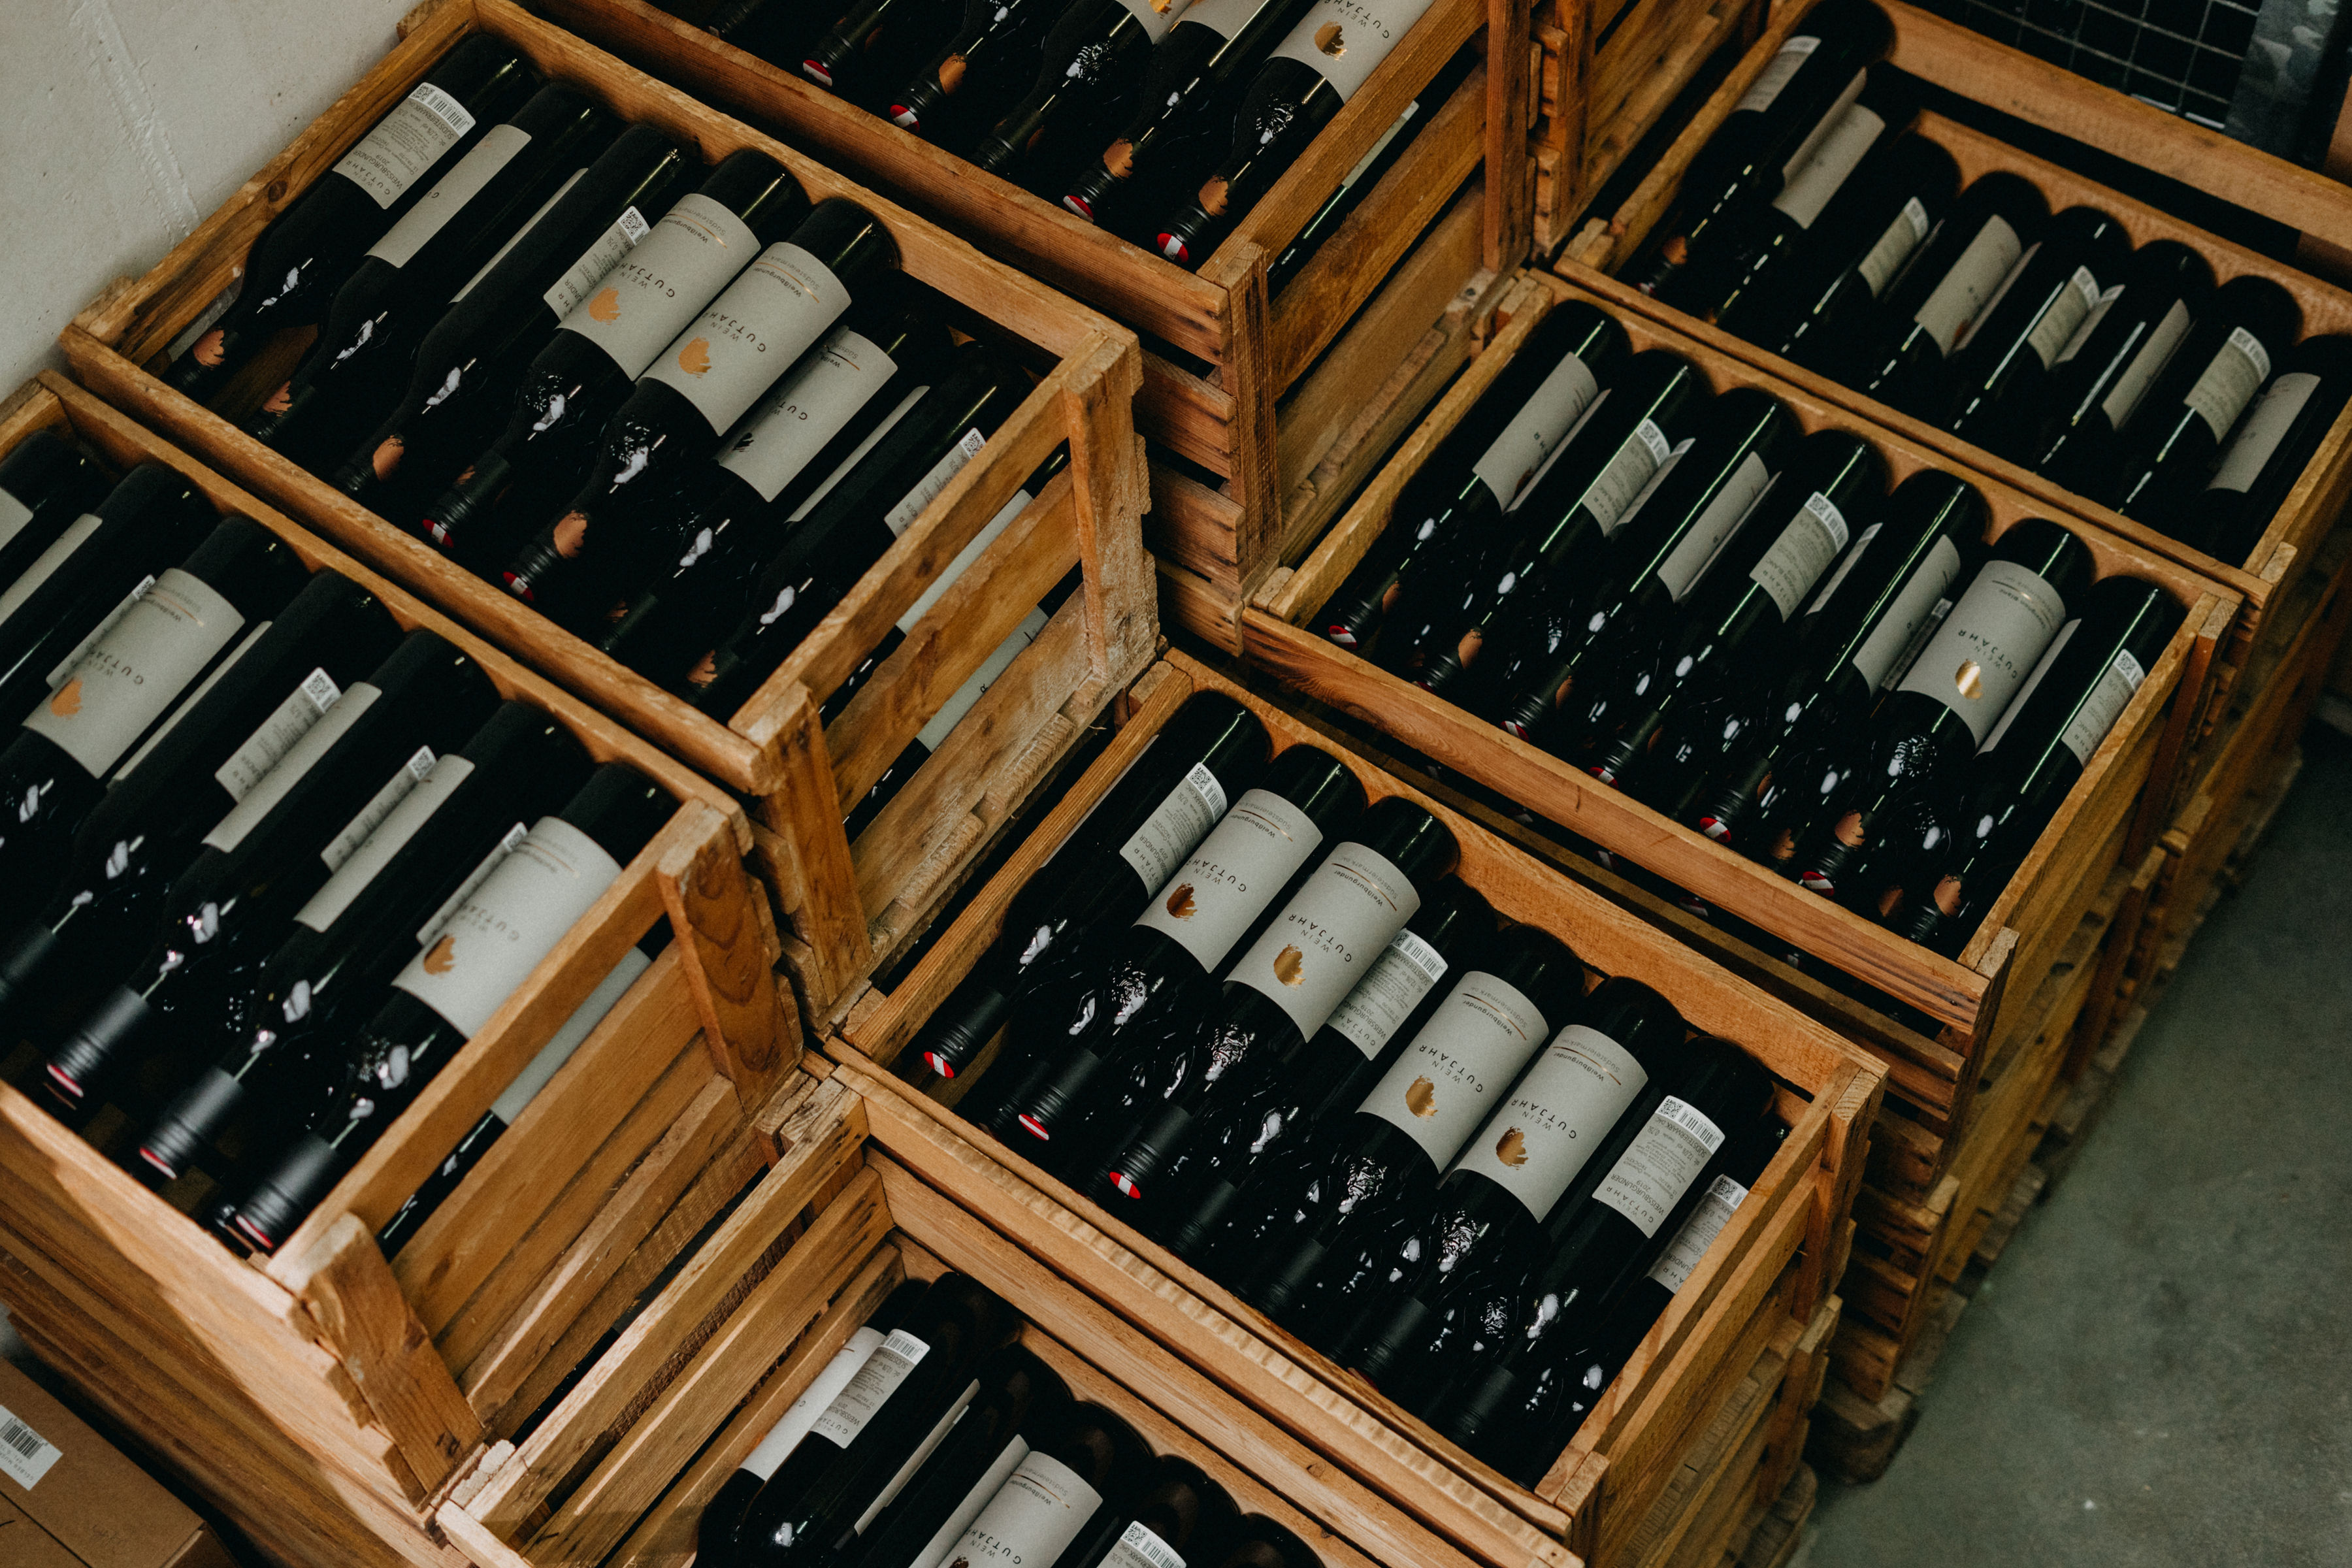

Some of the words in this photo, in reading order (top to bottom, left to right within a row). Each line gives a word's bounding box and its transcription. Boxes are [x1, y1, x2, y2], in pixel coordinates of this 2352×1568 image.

[1337, 7, 1366, 27] WEIN
[414, 104, 454, 140] SÜDSTEIERMARK
[353, 150, 402, 189] WEISSBURGUNDER
[375, 153, 390, 165] 2019
[346, 159, 390, 195] GUTJAHR
[619, 270, 647, 289] WEIN
[710, 321, 739, 342] WEIN
[1957, 629, 2016, 678] GUTJAHR
[1158, 847, 1168, 860] 2019
[1193, 867, 1220, 885] WEIN
[1333, 868, 1382, 906] Weißburgunder
[1350, 860, 1397, 898] Südsteiermark
[1287, 914, 1352, 962] GUTJAHR
[1299, 928, 1329, 953] WEIN
[1360, 1004, 1375, 1016] 2019
[1462, 998, 1512, 1036] Weißburgunder
[1478, 989, 1527, 1028] Südsteiermark
[1418, 1045, 1483, 1093] GUTJAHR
[1431, 1060, 1460, 1084] WEIN
[1553, 1051, 1604, 1081] Weißburgunder
[1510, 1098, 1576, 1139] GUTJAHR
[1521, 1110, 1551, 1131] WEIN
[1664, 1121, 1707, 1158] SÜDSTEIERMARK
[1610, 1173, 1664, 1215] WEISSBURGUNDER
[1635, 1179, 1651, 1192] 2019
[1605, 1185, 1654, 1223] GUTJAHR
[1615, 1199, 1637, 1217] WEIN
[970, 1539, 995, 1558] WEIN
